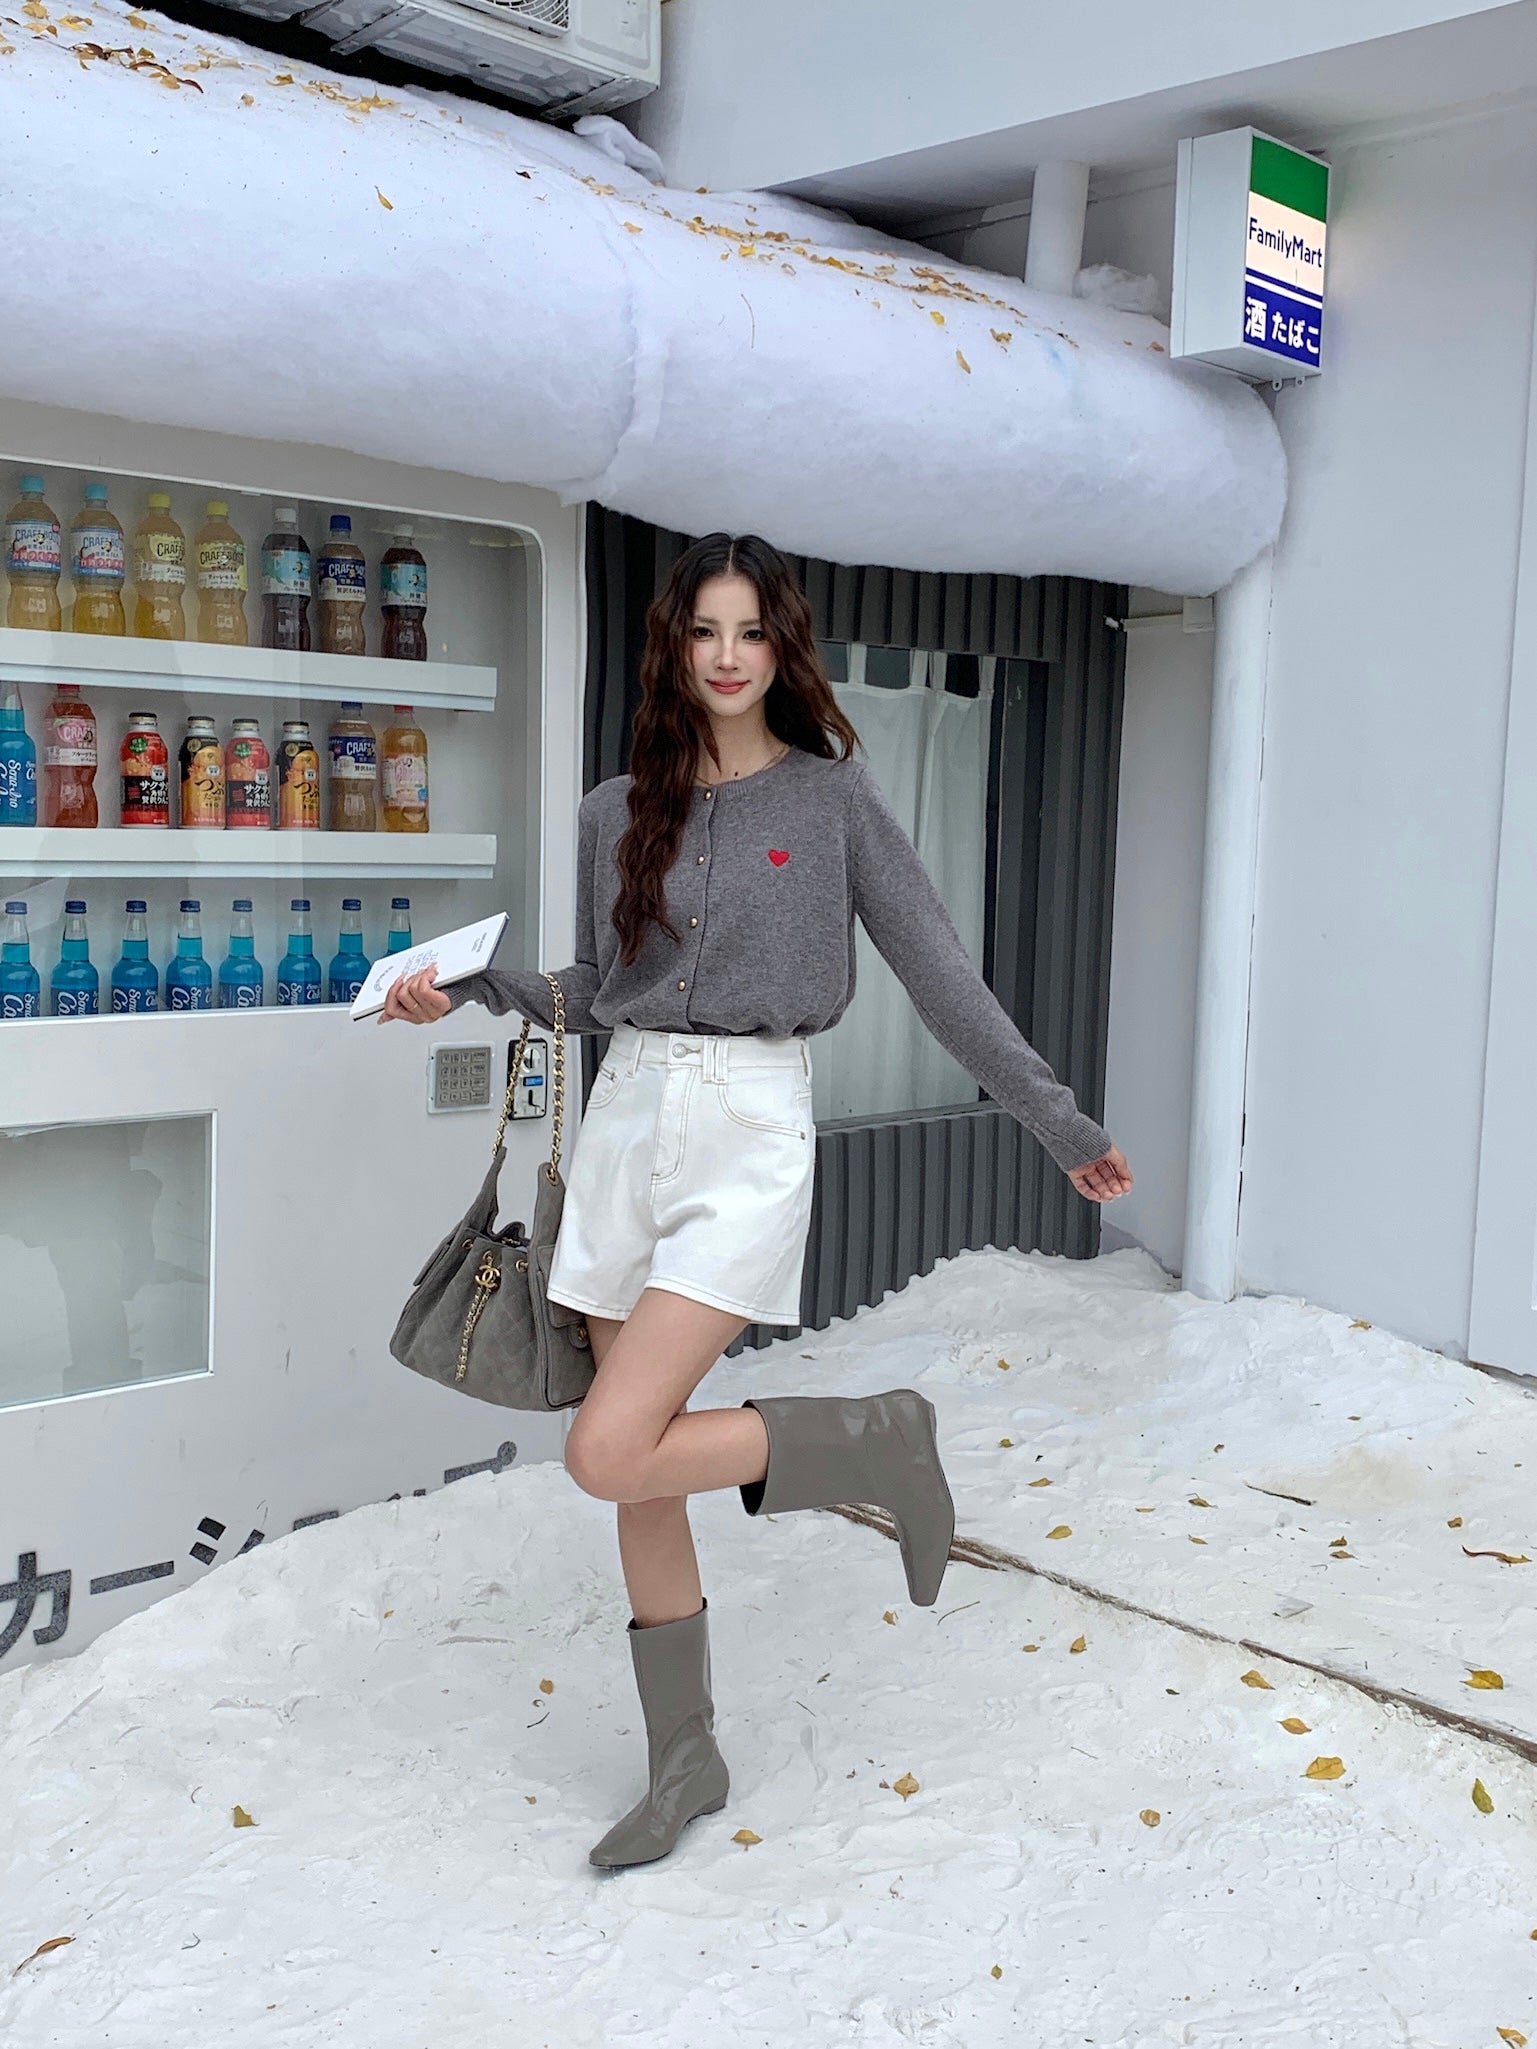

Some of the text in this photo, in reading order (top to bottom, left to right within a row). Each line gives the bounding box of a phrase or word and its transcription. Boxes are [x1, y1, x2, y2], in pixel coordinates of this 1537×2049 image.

[1249, 217, 1323, 268] FamilyMart
[1245, 297, 1320, 354] 酒 たばこ
